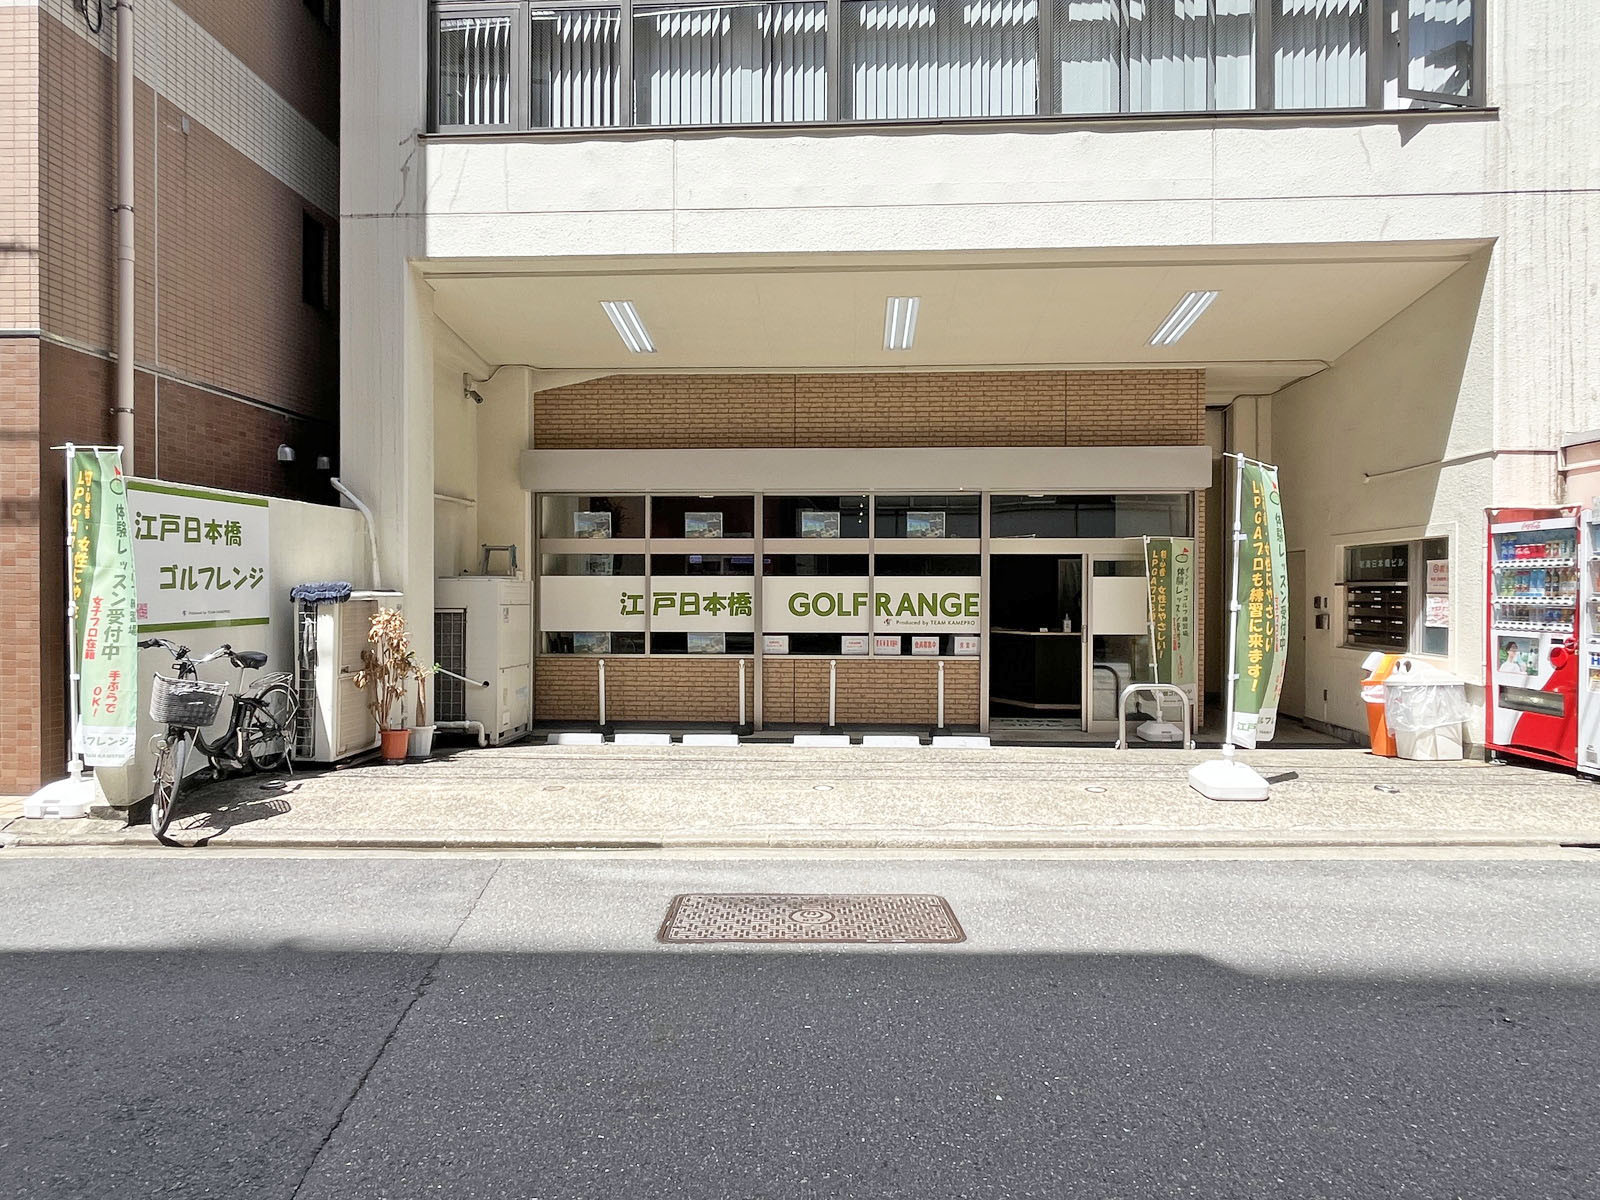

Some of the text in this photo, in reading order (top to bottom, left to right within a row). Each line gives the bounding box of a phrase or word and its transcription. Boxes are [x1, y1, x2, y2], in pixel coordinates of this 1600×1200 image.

[135, 511, 242, 546] 江戸日本橋
[101, 504, 128, 661] 体験レッスン受付中
[159, 564, 264, 591] ゴルフレンジ
[620, 592, 753, 617] 江戸日本橋
[788, 592, 980, 617] GOLF RANGE
[105, 670, 121, 714] 手ぶらで
[84, 736, 129, 747] フレンジ
